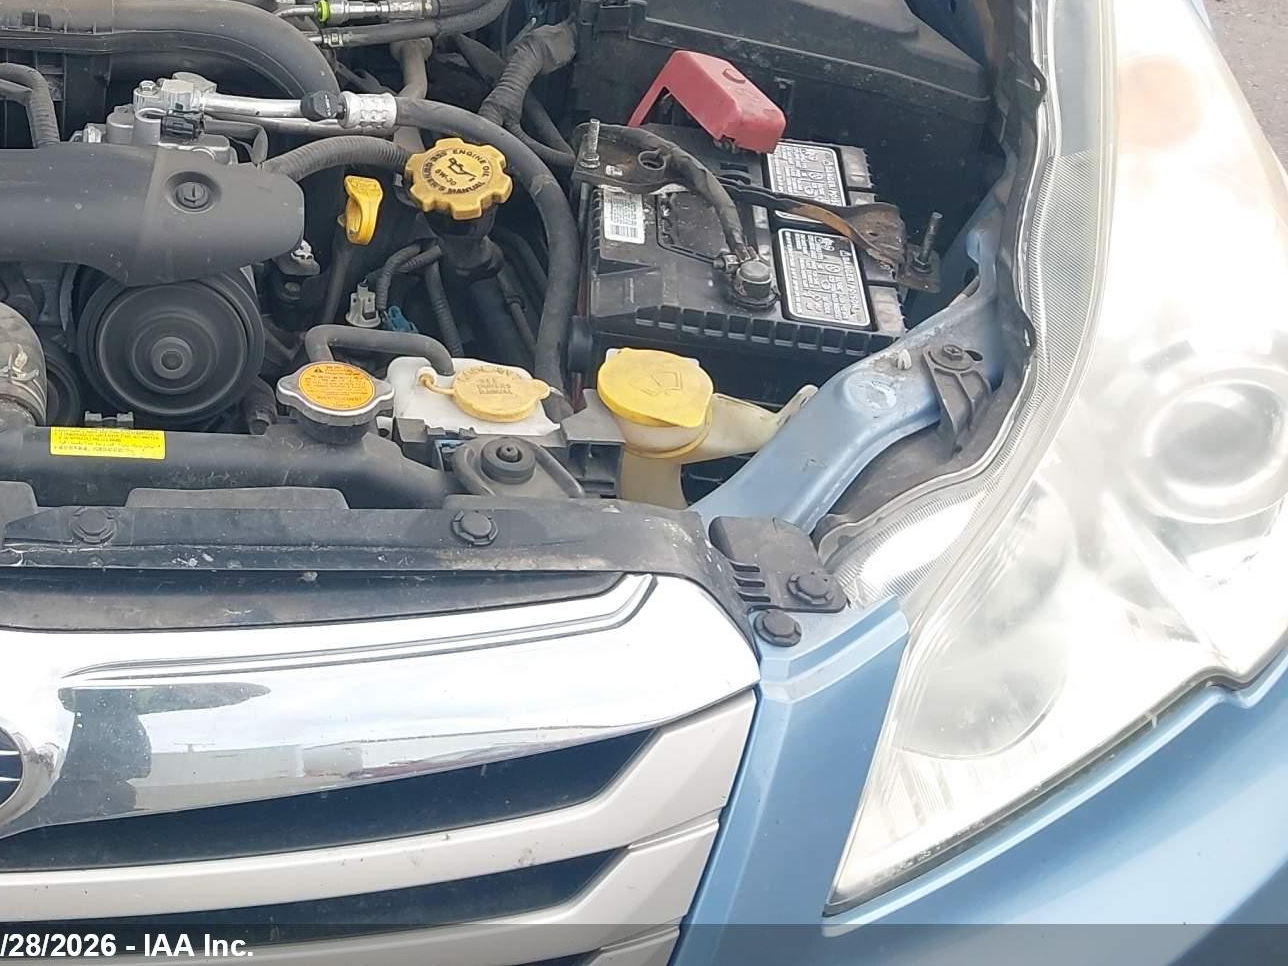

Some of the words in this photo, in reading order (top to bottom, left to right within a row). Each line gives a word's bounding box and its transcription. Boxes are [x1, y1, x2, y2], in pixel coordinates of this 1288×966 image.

[452, 148, 487, 164] ENGINE
[482, 164, 490, 178] OIL
[447, 180, 486, 194] MANUAL
